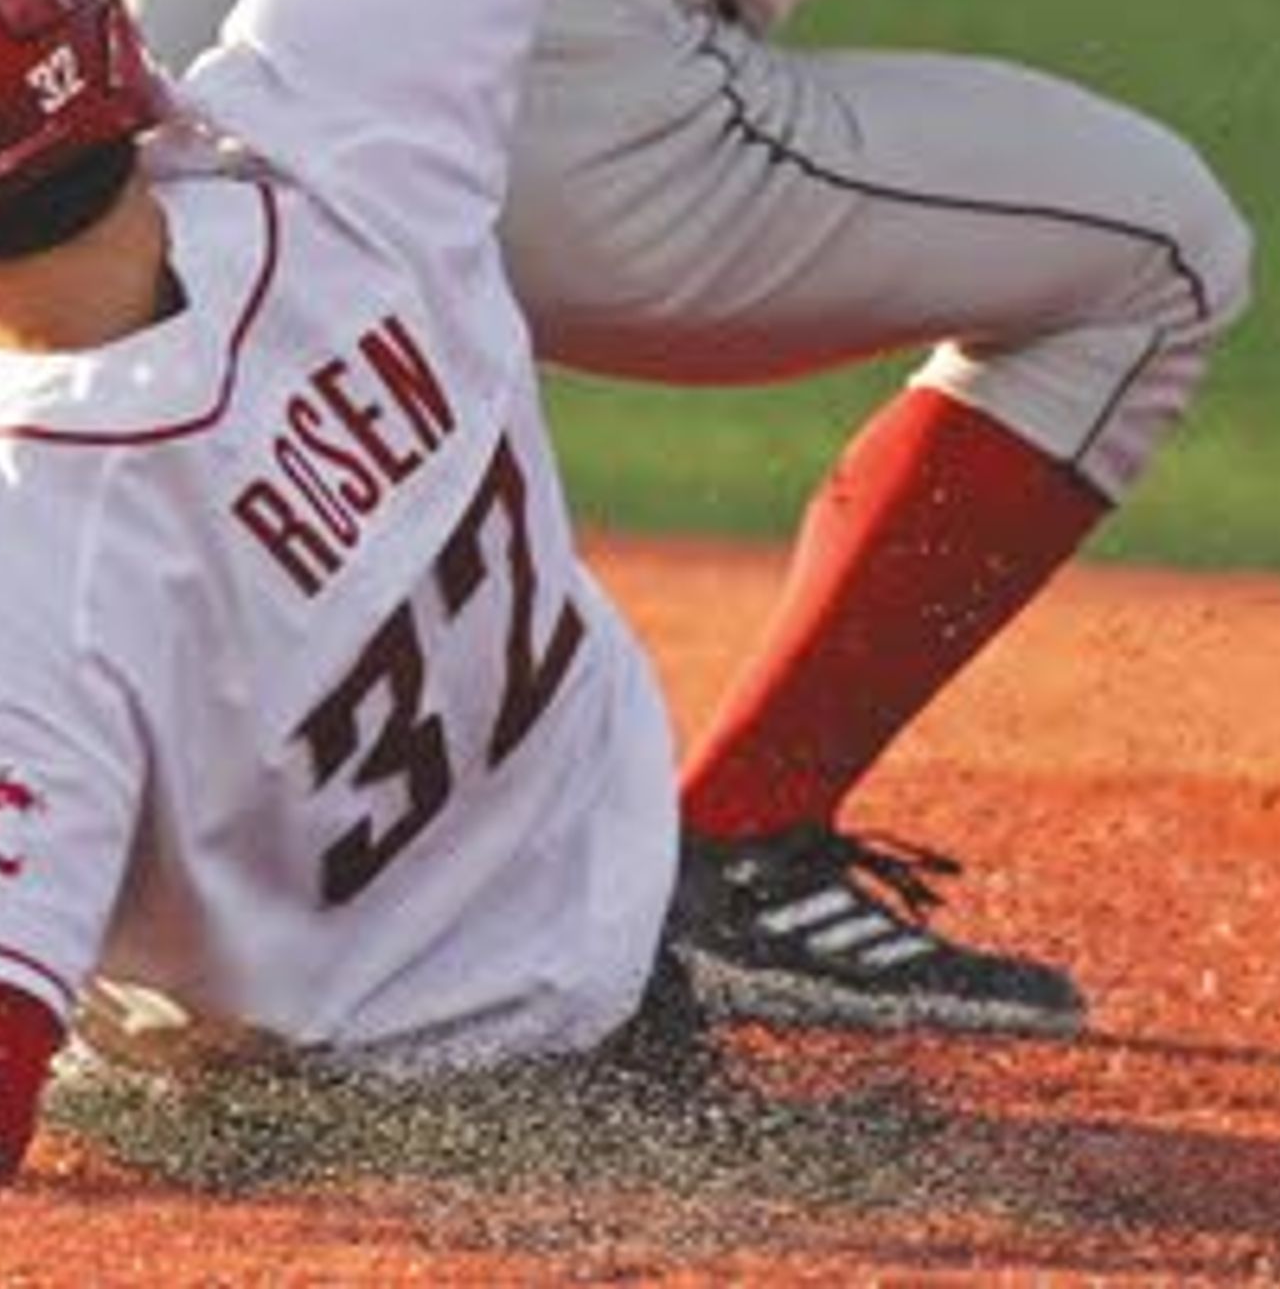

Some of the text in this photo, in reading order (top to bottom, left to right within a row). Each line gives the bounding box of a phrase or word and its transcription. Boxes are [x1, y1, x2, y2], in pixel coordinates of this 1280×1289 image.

[25, 45, 86, 113] 32
[231, 315, 455, 598] ROSEN
[288, 431, 587, 912] 32
